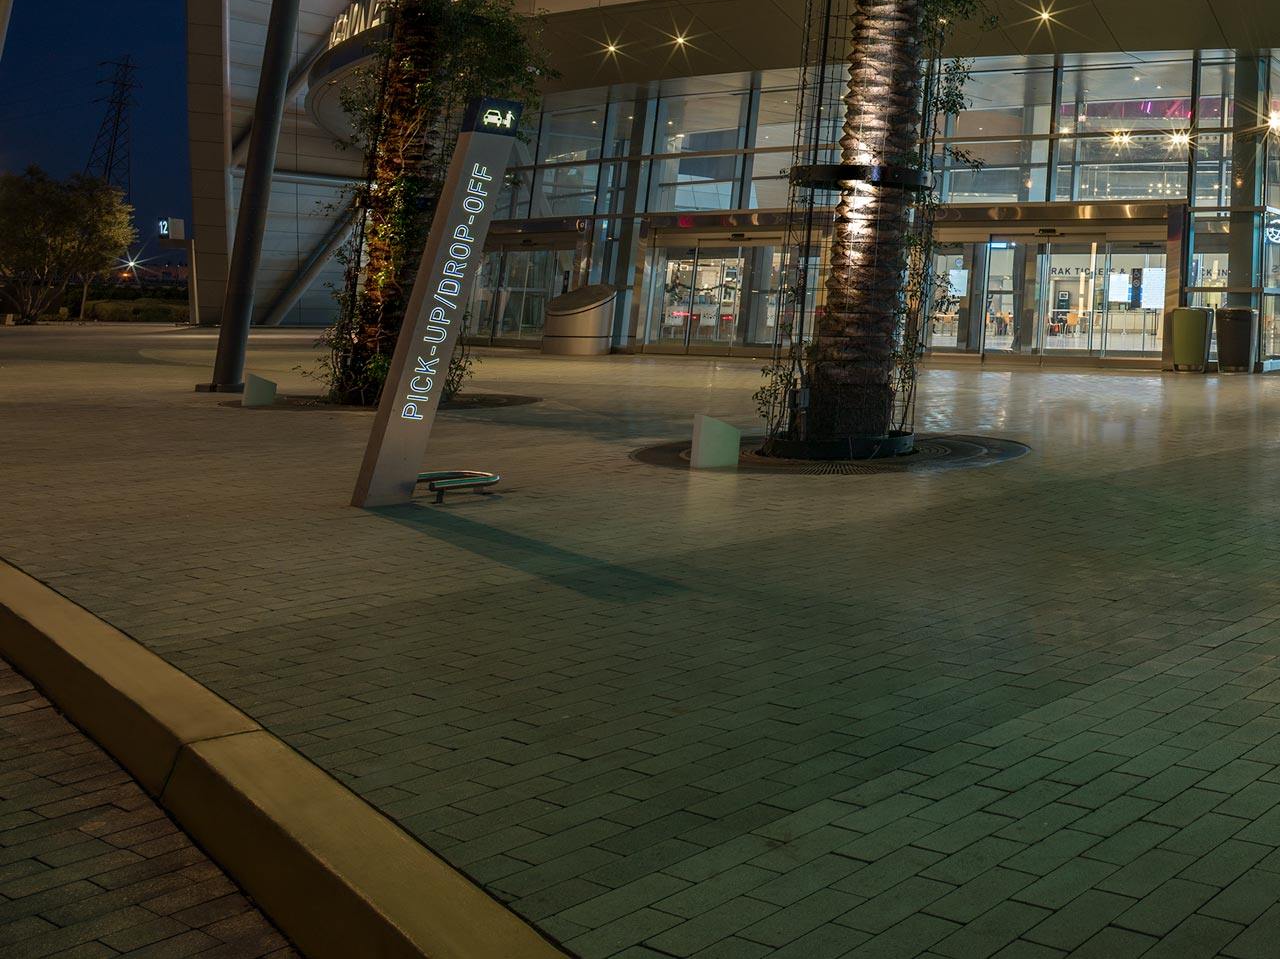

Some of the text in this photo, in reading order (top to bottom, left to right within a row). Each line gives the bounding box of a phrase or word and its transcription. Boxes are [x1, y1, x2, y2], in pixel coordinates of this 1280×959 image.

[159, 220, 168, 234] 12
[1051, 267, 1071, 275] RAK
[401, 162, 493, 421] PICK-UP/DROP-OFF
